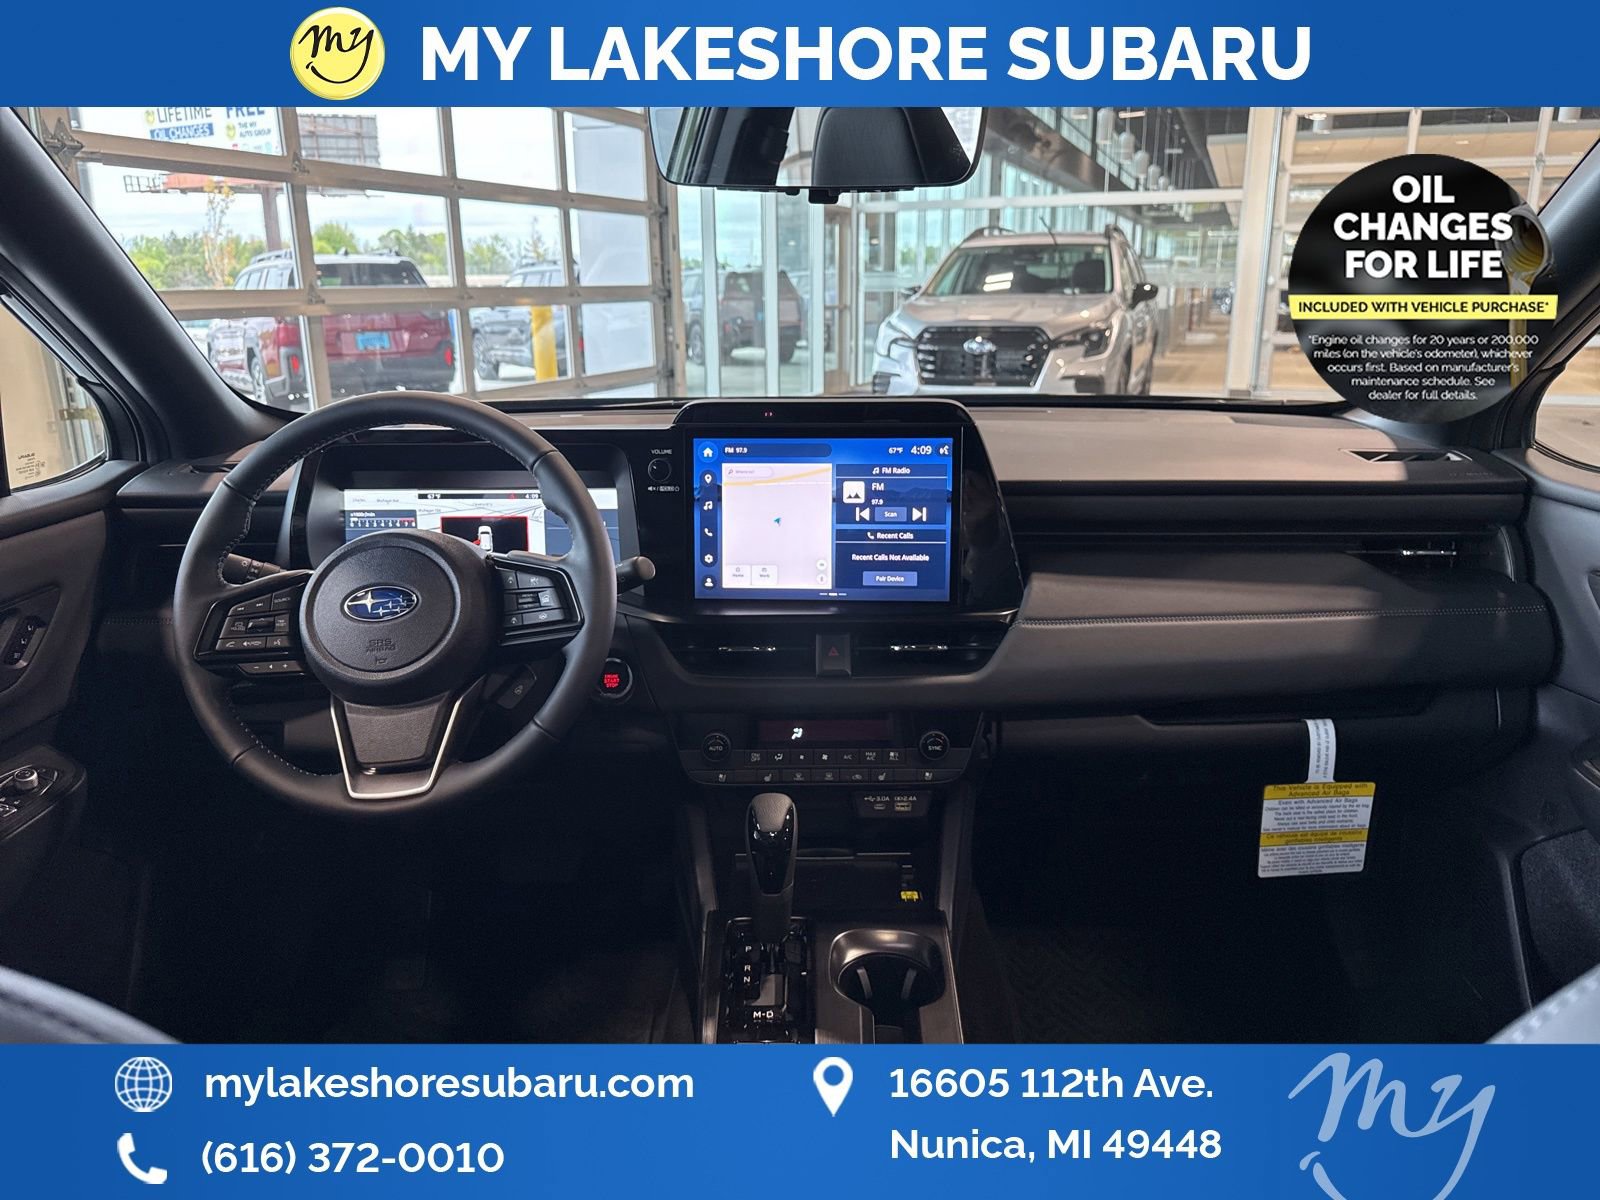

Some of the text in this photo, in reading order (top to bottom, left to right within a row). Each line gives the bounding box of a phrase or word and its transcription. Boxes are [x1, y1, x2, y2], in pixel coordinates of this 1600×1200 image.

[157, 107, 212, 123] LIFETIME
[168, 126, 210, 139] CHANGES
[910, 445, 933, 455] 4:09
[881, 467, 911, 475] FM Radio
[871, 483, 885, 492] FM
[876, 532, 914, 540] Recent Calls
[873, 553, 888, 561] Calls
[888, 553, 902, 561] Not
[901, 553, 930, 562] Available
[745, 945, 752, 953] P
